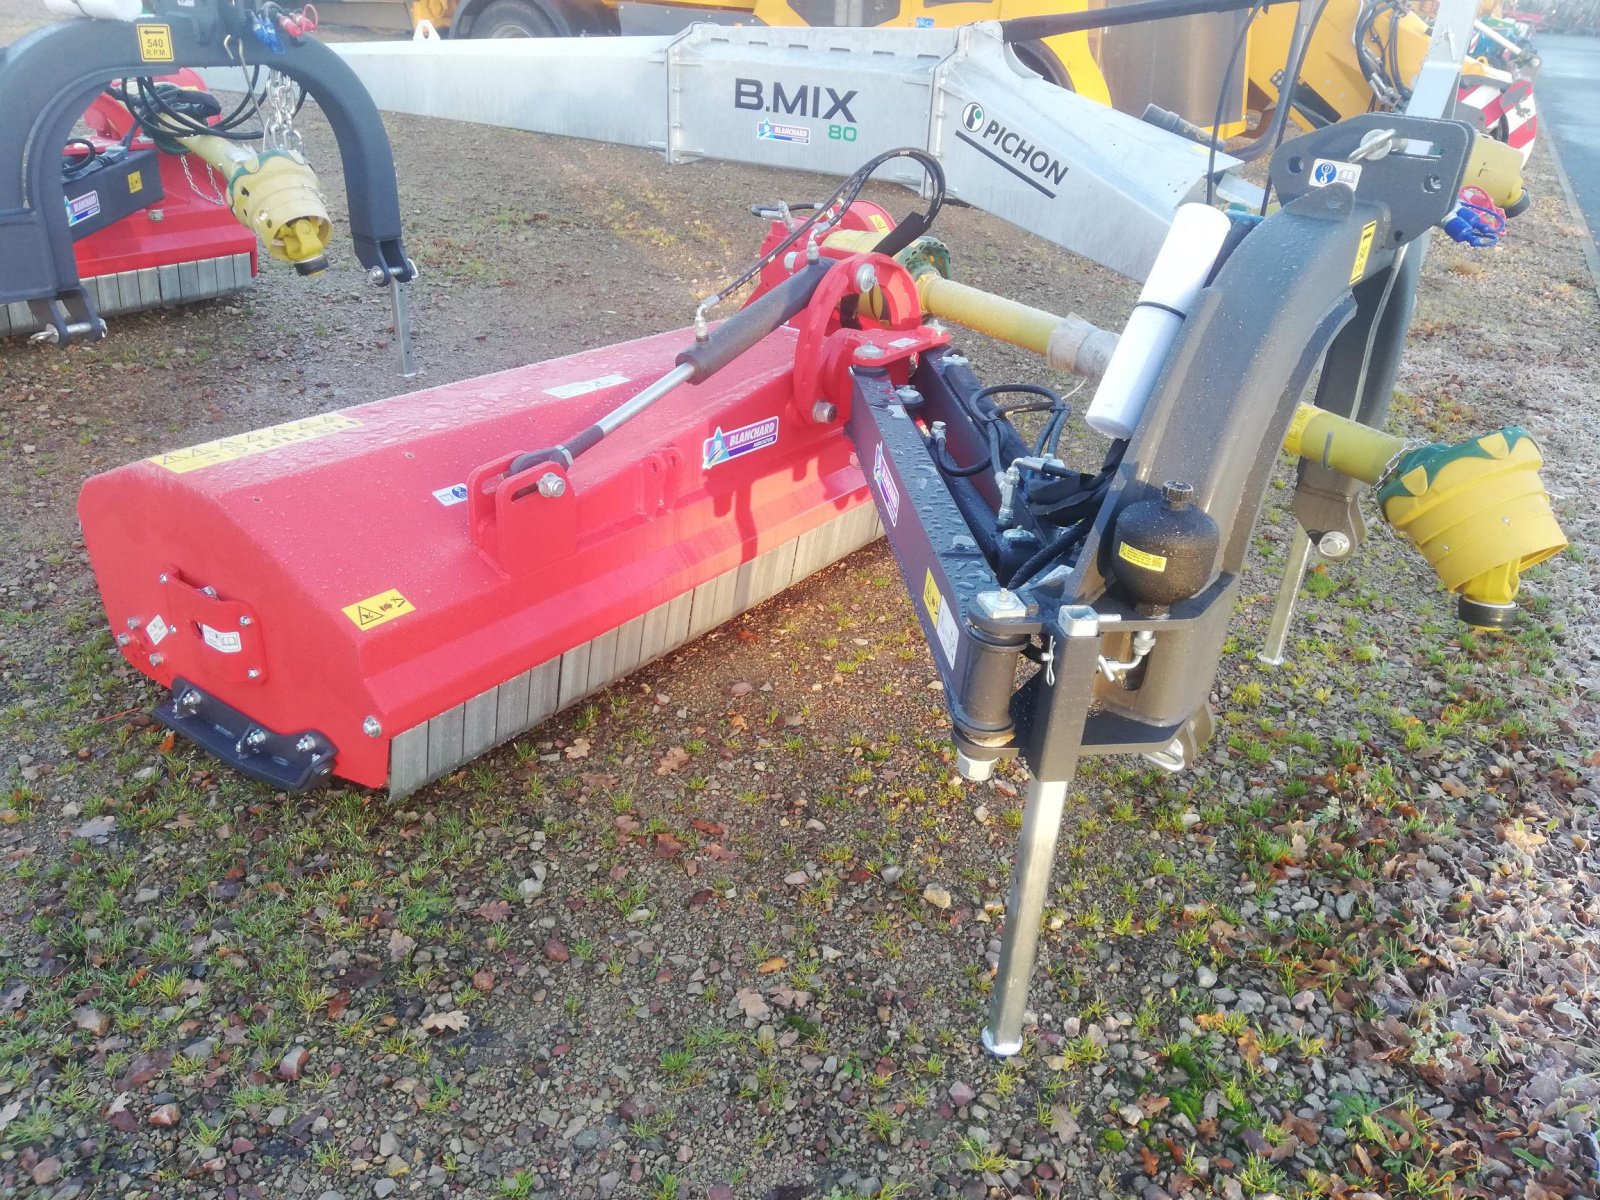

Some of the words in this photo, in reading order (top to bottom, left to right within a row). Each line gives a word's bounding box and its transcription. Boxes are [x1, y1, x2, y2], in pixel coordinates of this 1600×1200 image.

[147, 38, 164, 48] 540
[734, 78, 859, 123] B.MIX
[774, 126, 808, 137] BLANCHARD
[828, 124, 857, 142] 80
[982, 119, 1069, 186] PICHON
[730, 423, 775, 446] BLANCHARD
